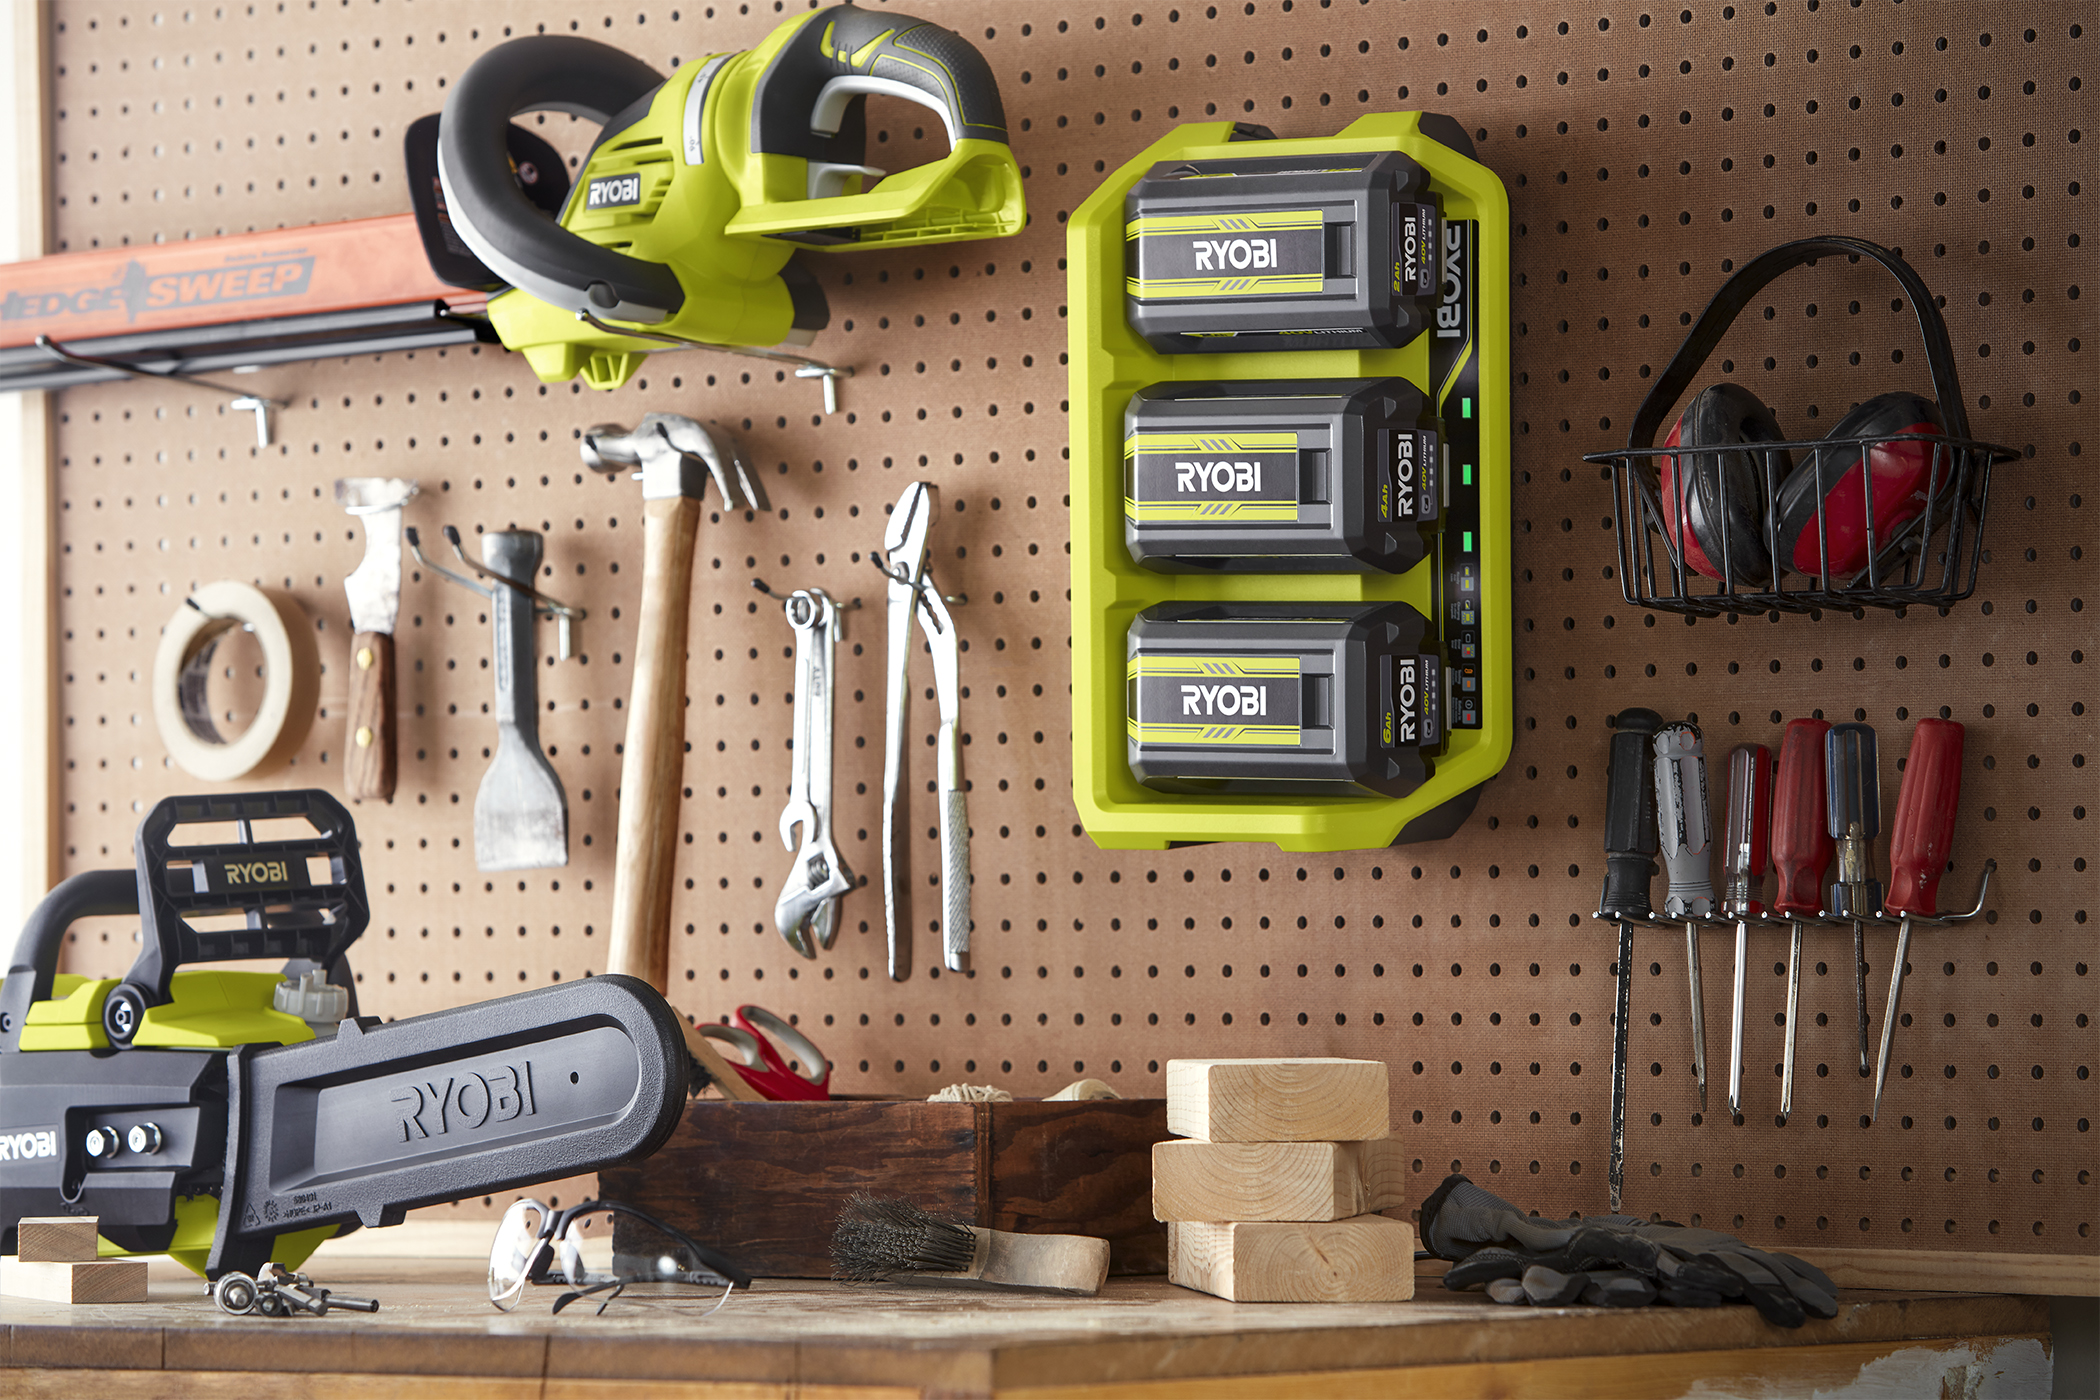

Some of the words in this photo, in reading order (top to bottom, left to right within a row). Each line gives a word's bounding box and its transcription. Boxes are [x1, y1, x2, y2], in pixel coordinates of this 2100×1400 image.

[588, 177, 639, 206] RYOBI
[1192, 238, 1278, 271] RYOBI
[1404, 216, 1417, 282] RYOBI
[145, 262, 303, 308] SWEEP
[1393, 261, 1401, 293] 2Ah
[1174, 460, 1262, 493] RYOBI
[1397, 433, 1413, 518] RYOBI
[1380, 483, 1389, 519] 4Ah
[1180, 684, 1267, 717] RYOBI
[1400, 658, 1416, 743] RYOBI
[1383, 711, 1392, 744] 6Ah
[224, 861, 289, 885] RYOBI
[389, 1060, 537, 1143] RYOBI
